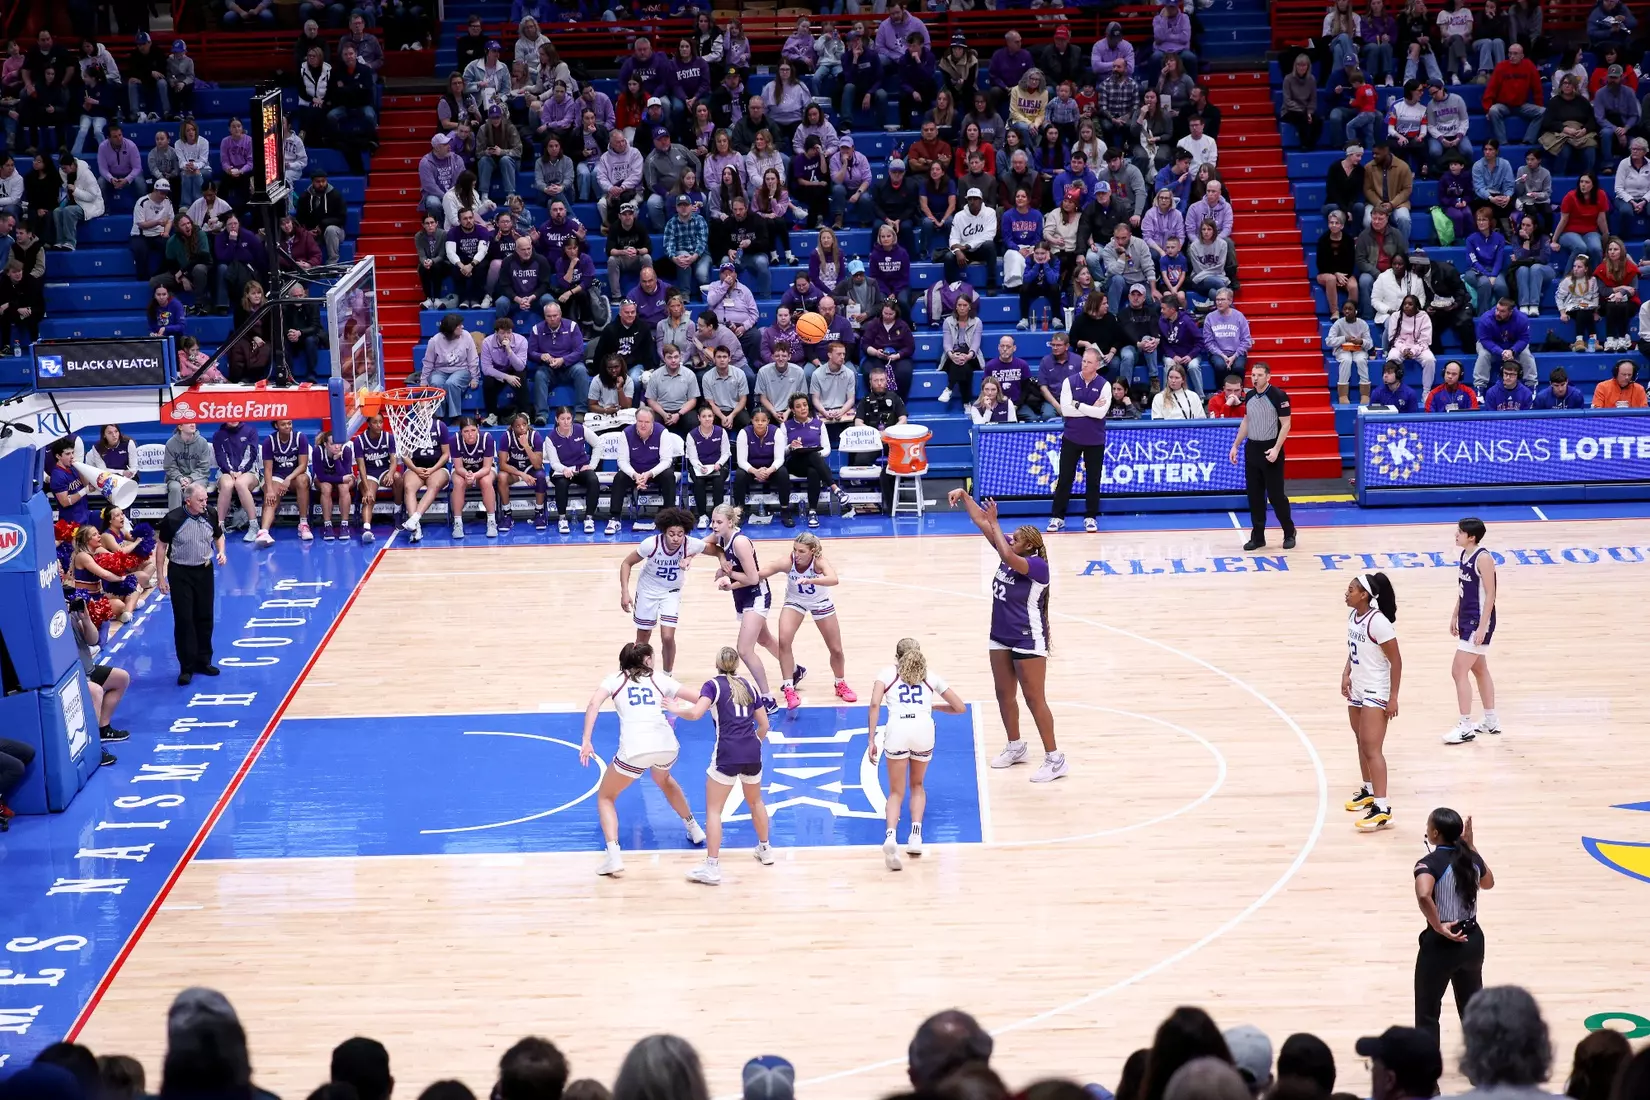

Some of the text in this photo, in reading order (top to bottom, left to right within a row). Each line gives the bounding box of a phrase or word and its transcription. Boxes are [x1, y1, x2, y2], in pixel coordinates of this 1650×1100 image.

[1226, 0, 1234, 10] 2
[1231, 30, 1237, 40] 1
[676, 67, 701, 80] K-STATE
[1017, 97, 1042, 110] KANSAS
[962, 223, 984, 237] Cats
[512, 269, 538, 278] K-STATE
[992, 368, 1022, 378] K-STATE
[36, 412, 72, 434] KU
[845, 429, 875, 438] Capitol
[845, 437, 876, 445] Federal
[136, 448, 165, 458] Capito
[365, 451, 390, 461] Wildcats
[909, 443, 920, 457] G
[1103, 440, 1201, 462] KANSAS
[1433, 438, 1551, 463] KANSAS
[137, 457, 165, 466] Federa
[518, 460, 526, 469] 5
[1100, 462, 1216, 485] LOTTERY
[653, 557, 680, 567] JAYHAW
[1076, 546, 1650, 577] ALLEN FIELHOU
[656, 566, 680, 581] 25
[797, 583, 816, 595] 13
[993, 581, 1007, 602] 22
[1348, 641, 1360, 665] 2
[627, 686, 656, 706] 52
[899, 684, 923, 705] 22
[46, 691, 258, 896] NAISMITH
[218, 579, 333, 667] COURT
